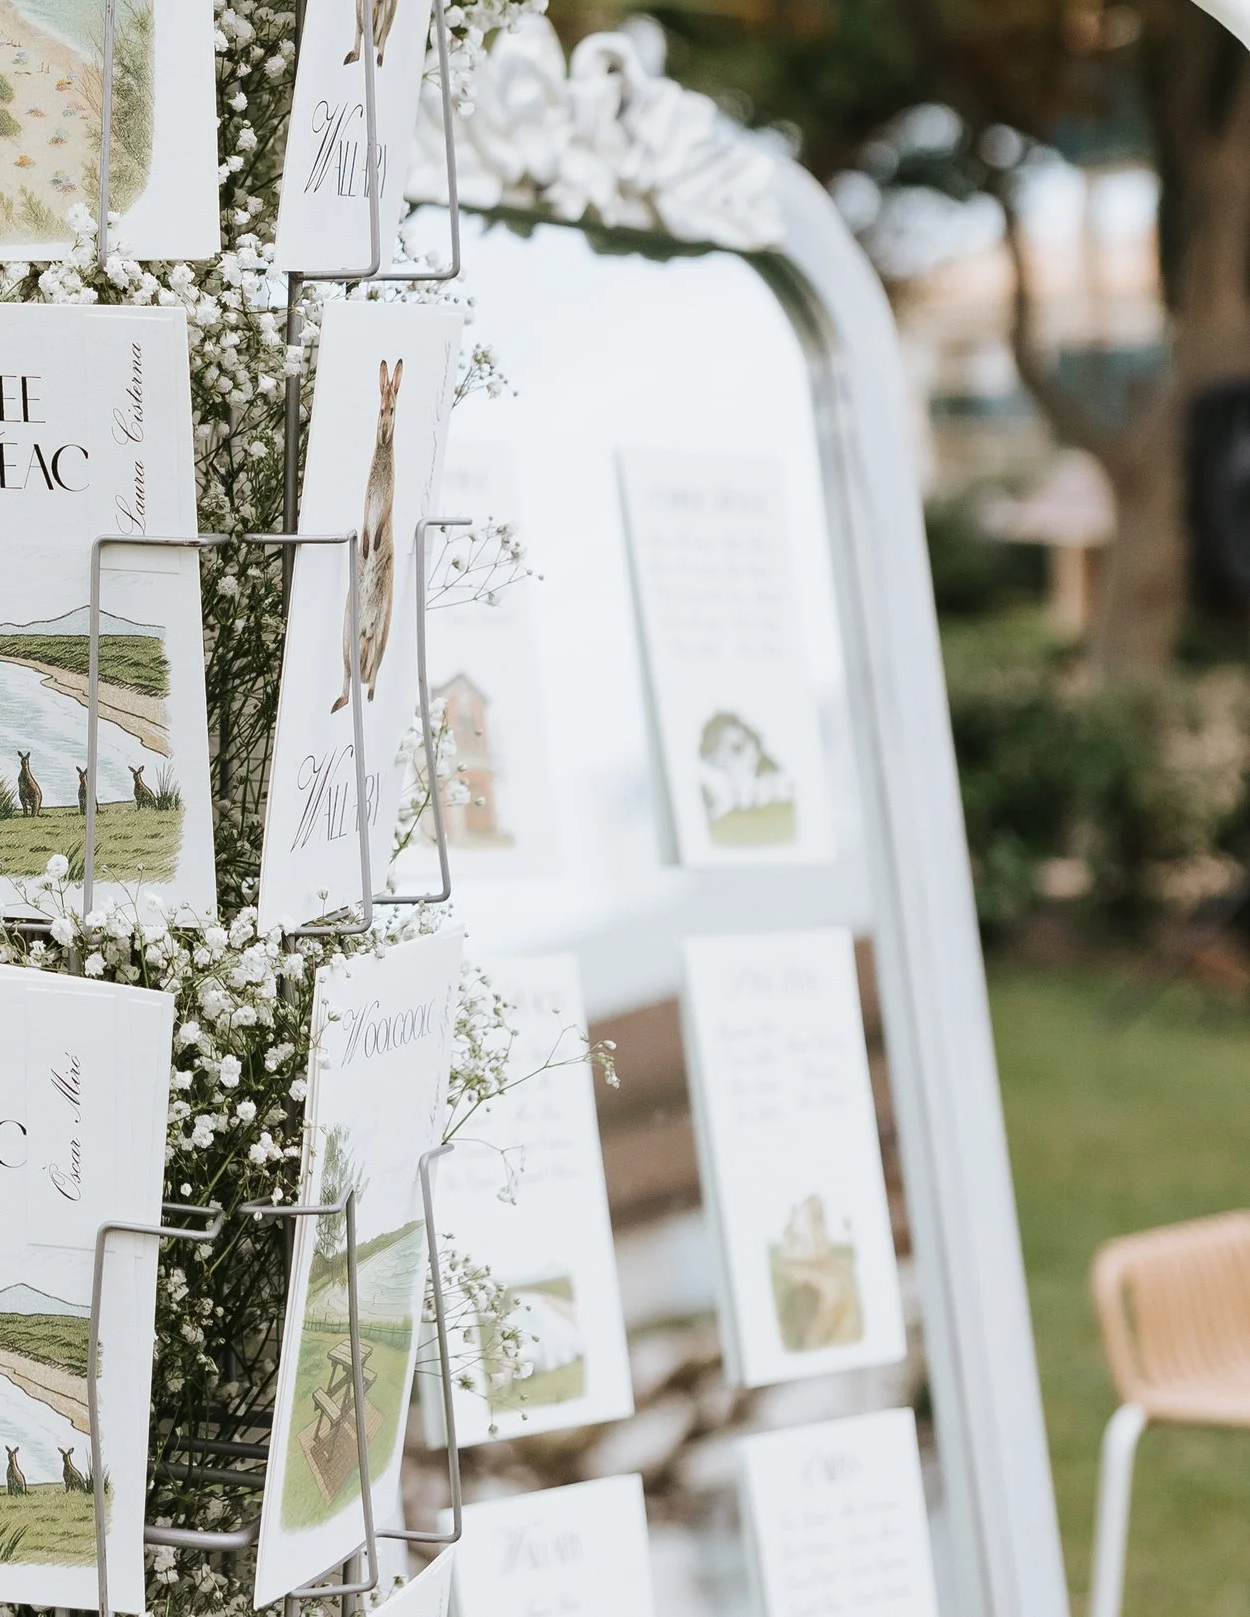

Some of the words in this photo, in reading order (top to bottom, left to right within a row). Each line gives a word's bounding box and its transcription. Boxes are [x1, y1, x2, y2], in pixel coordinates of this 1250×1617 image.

[111, 342, 145, 446] Cisterna
[114, 460, 147, 535] Laura
[50, 1051, 83, 1124] Miró
